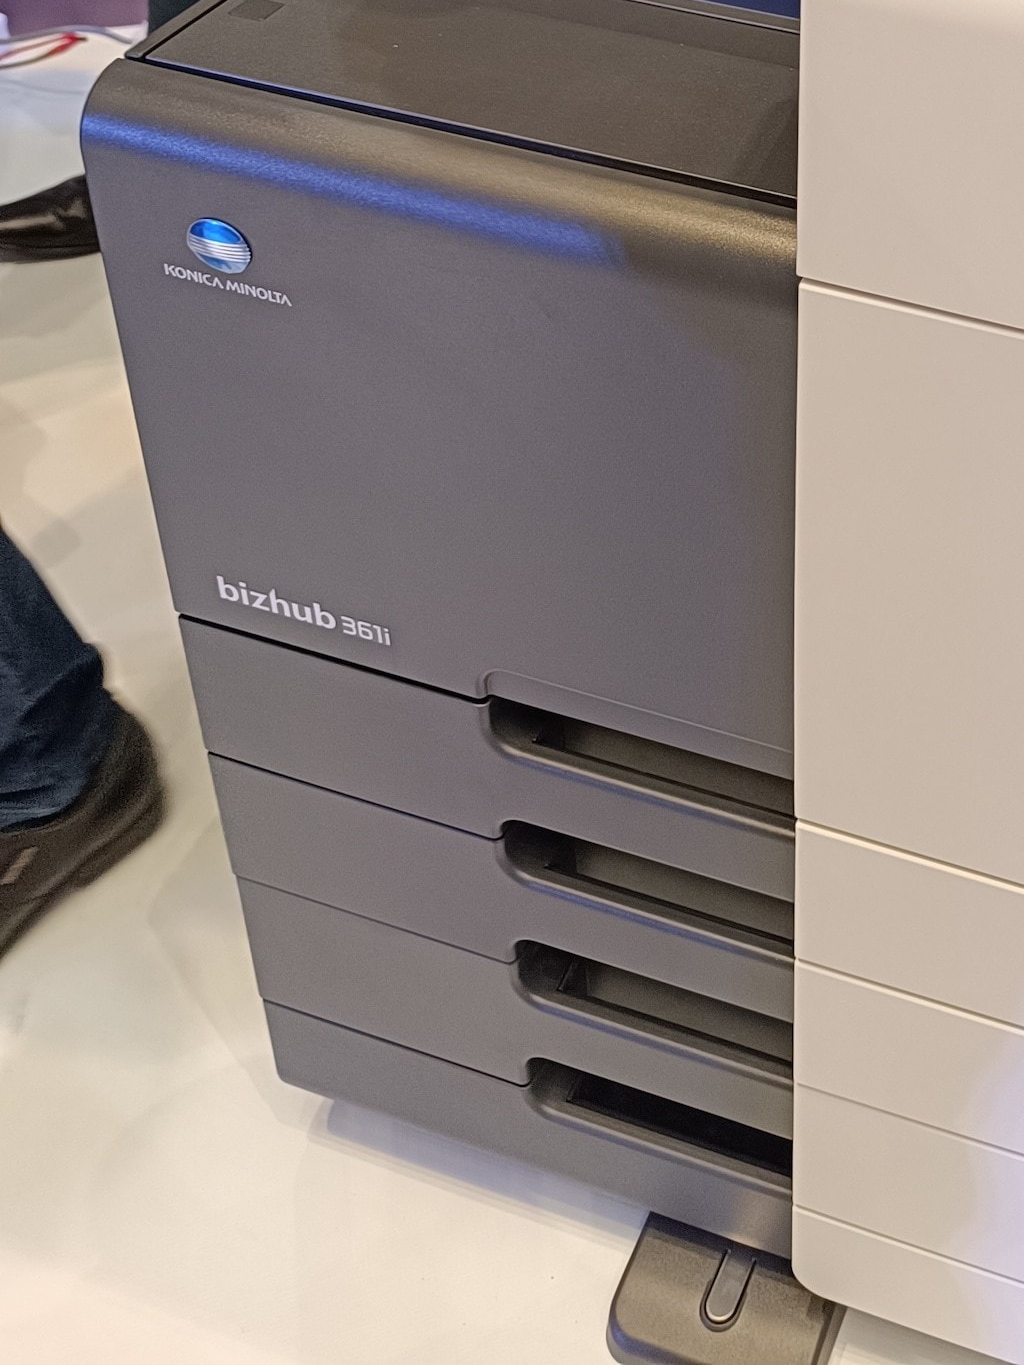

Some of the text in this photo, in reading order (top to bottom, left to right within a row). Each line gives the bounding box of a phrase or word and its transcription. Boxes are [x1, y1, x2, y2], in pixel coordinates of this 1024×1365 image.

[163, 263, 293, 307] KONICA MINOLTA
[216, 575, 391, 646] bizhub 361i
